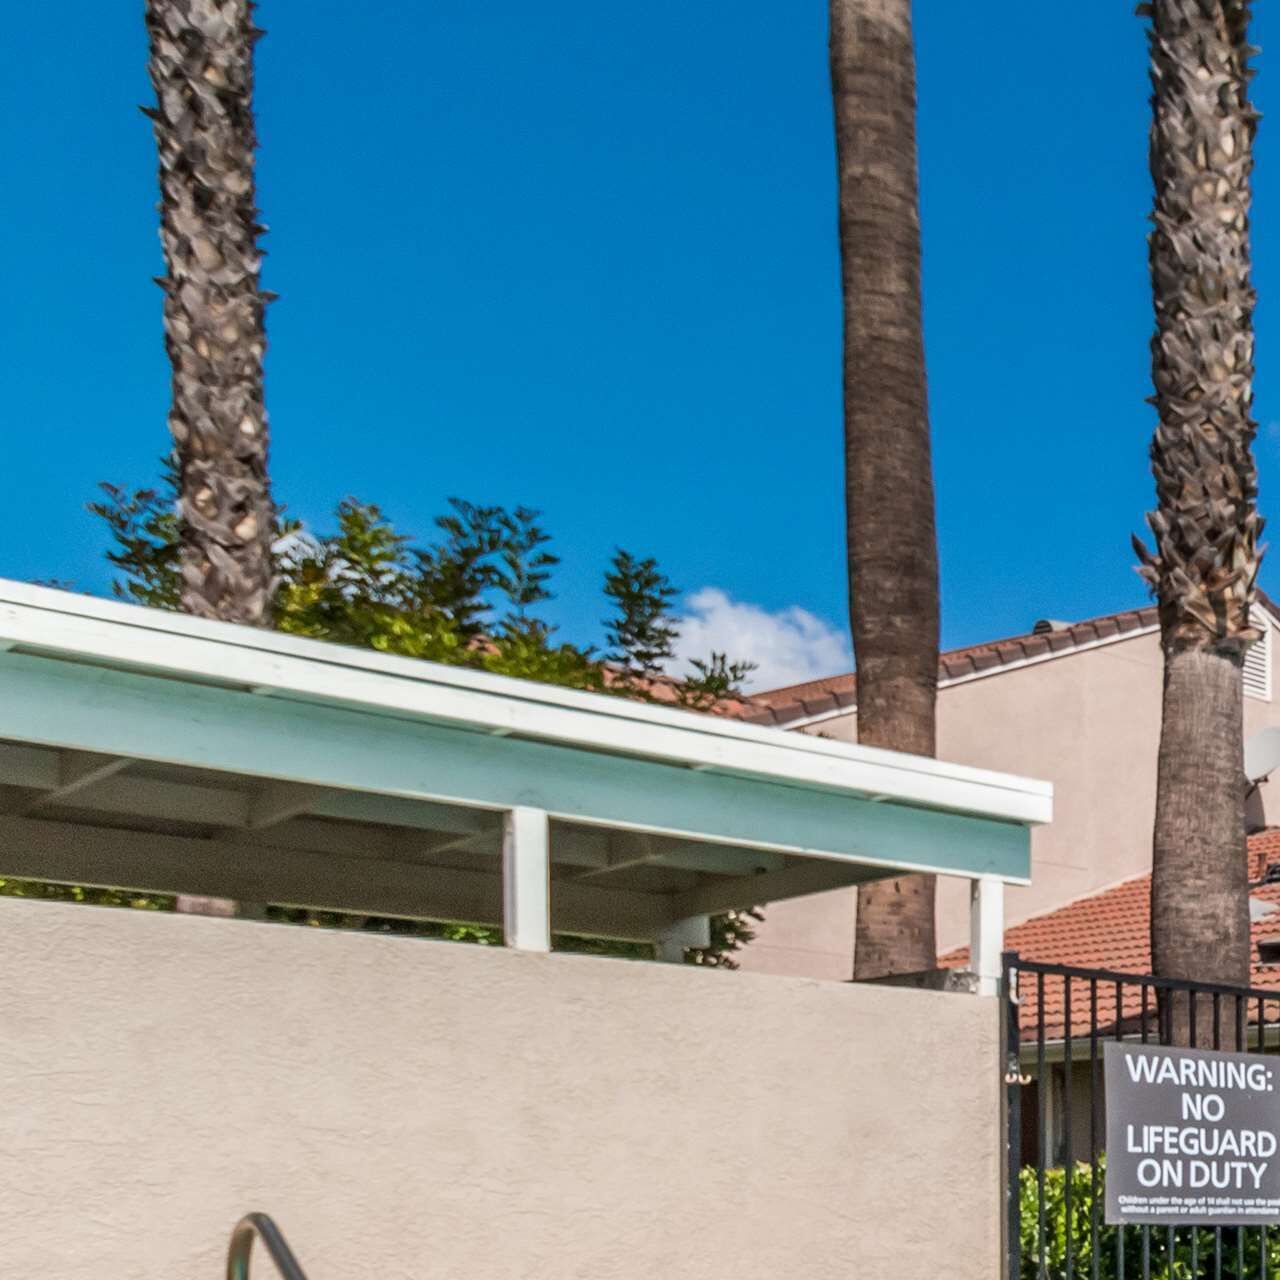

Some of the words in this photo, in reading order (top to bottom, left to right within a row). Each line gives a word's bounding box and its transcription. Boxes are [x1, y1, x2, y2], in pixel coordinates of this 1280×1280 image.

[1125, 1053, 1273, 1092] WARNING:
[1182, 1092, 1225, 1122] NO
[1127, 1124, 1277, 1158] LIFEGUARD
[1137, 1158, 1183, 1187] ON
[1190, 1159, 1267, 1189] DUTY
